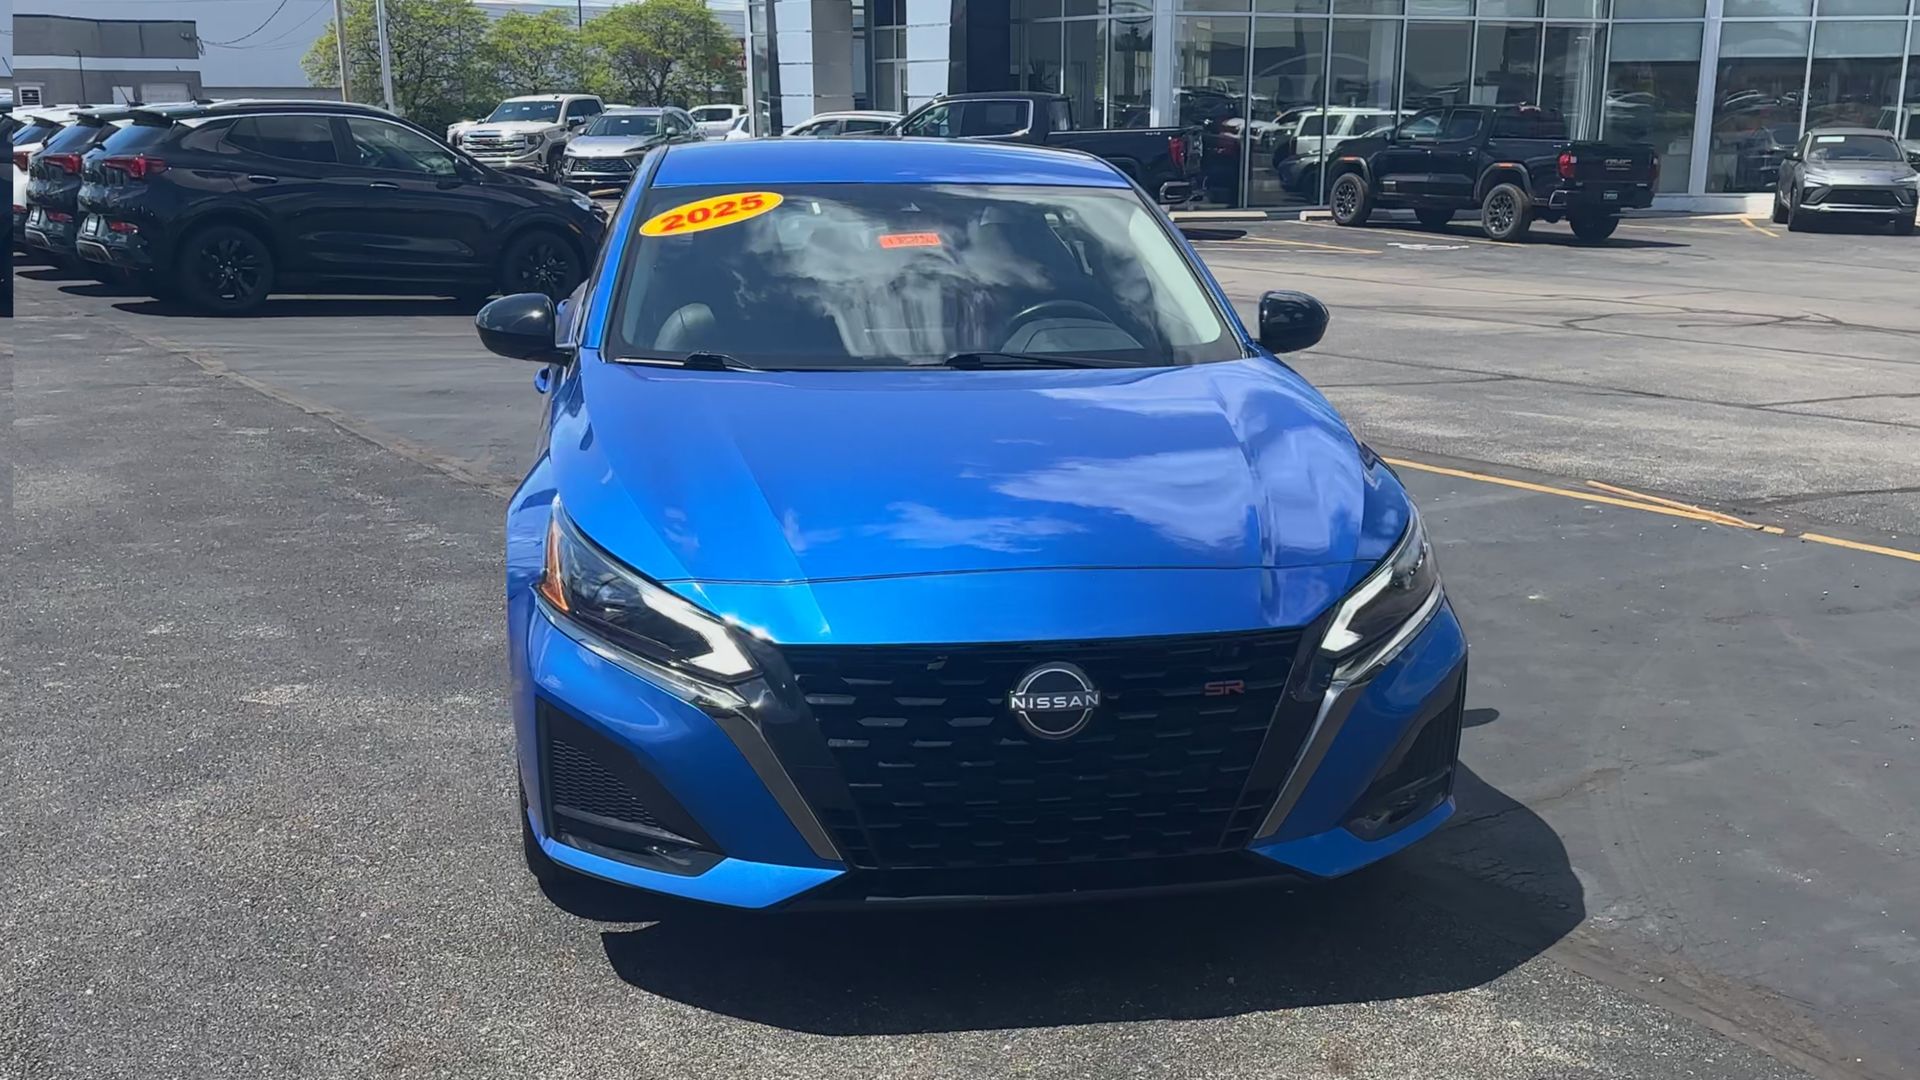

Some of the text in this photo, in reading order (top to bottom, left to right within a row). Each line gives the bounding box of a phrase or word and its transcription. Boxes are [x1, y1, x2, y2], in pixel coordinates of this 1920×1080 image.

[660, 194, 765, 232] 2025
[1204, 679, 1245, 696] SR
[1011, 693, 1100, 710] NISSAN
